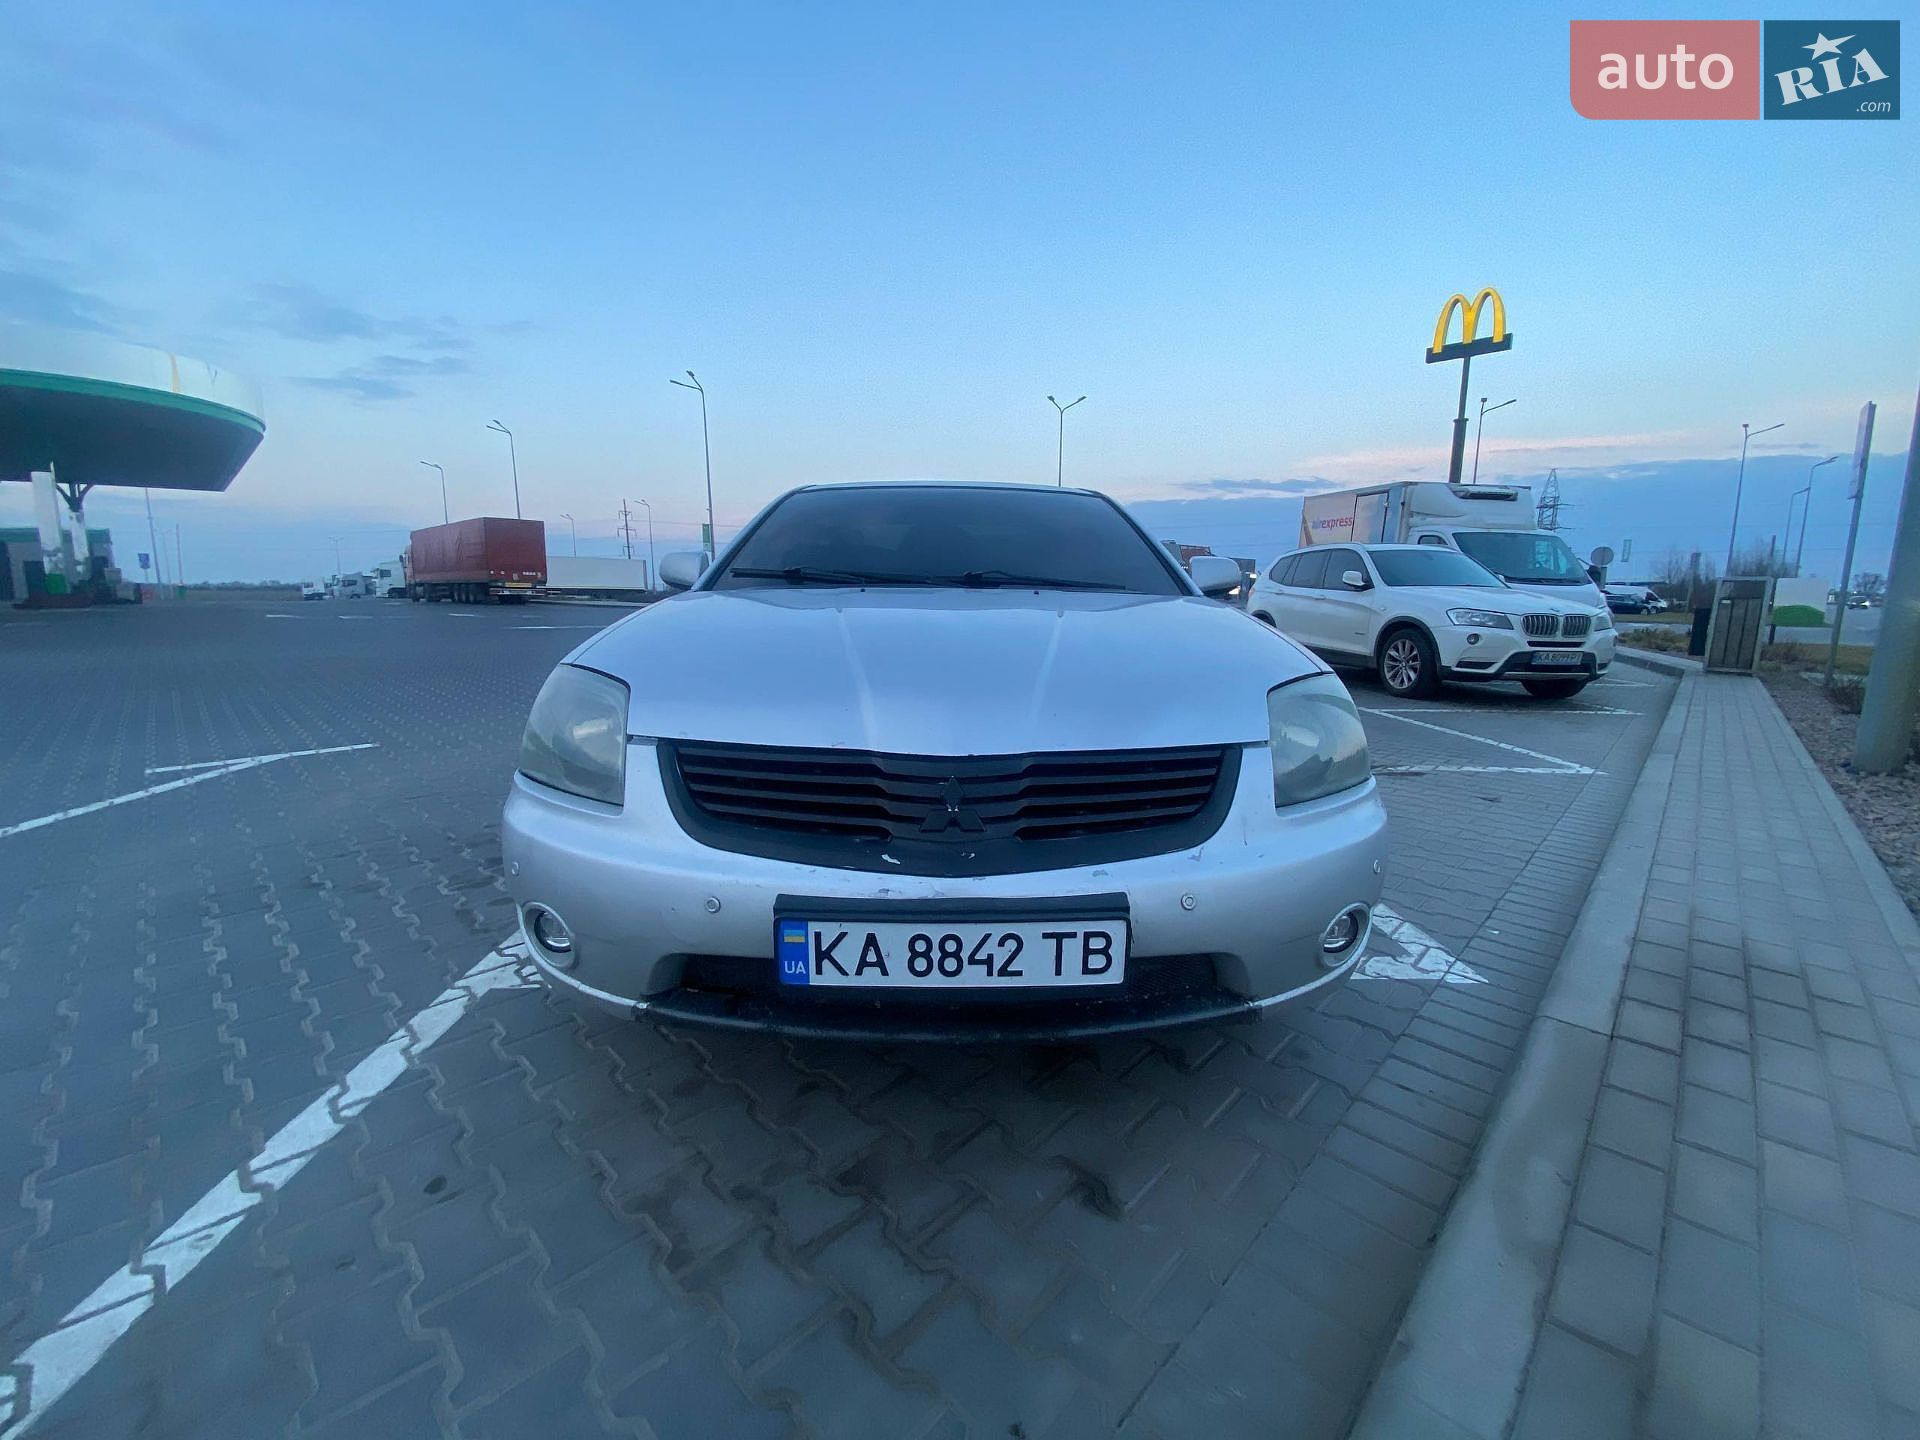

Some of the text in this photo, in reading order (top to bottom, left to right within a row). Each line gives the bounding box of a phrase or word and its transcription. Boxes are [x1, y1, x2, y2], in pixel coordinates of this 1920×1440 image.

[784, 961, 807, 975] UA
[813, 931, 1113, 978] KA 8842 TB
